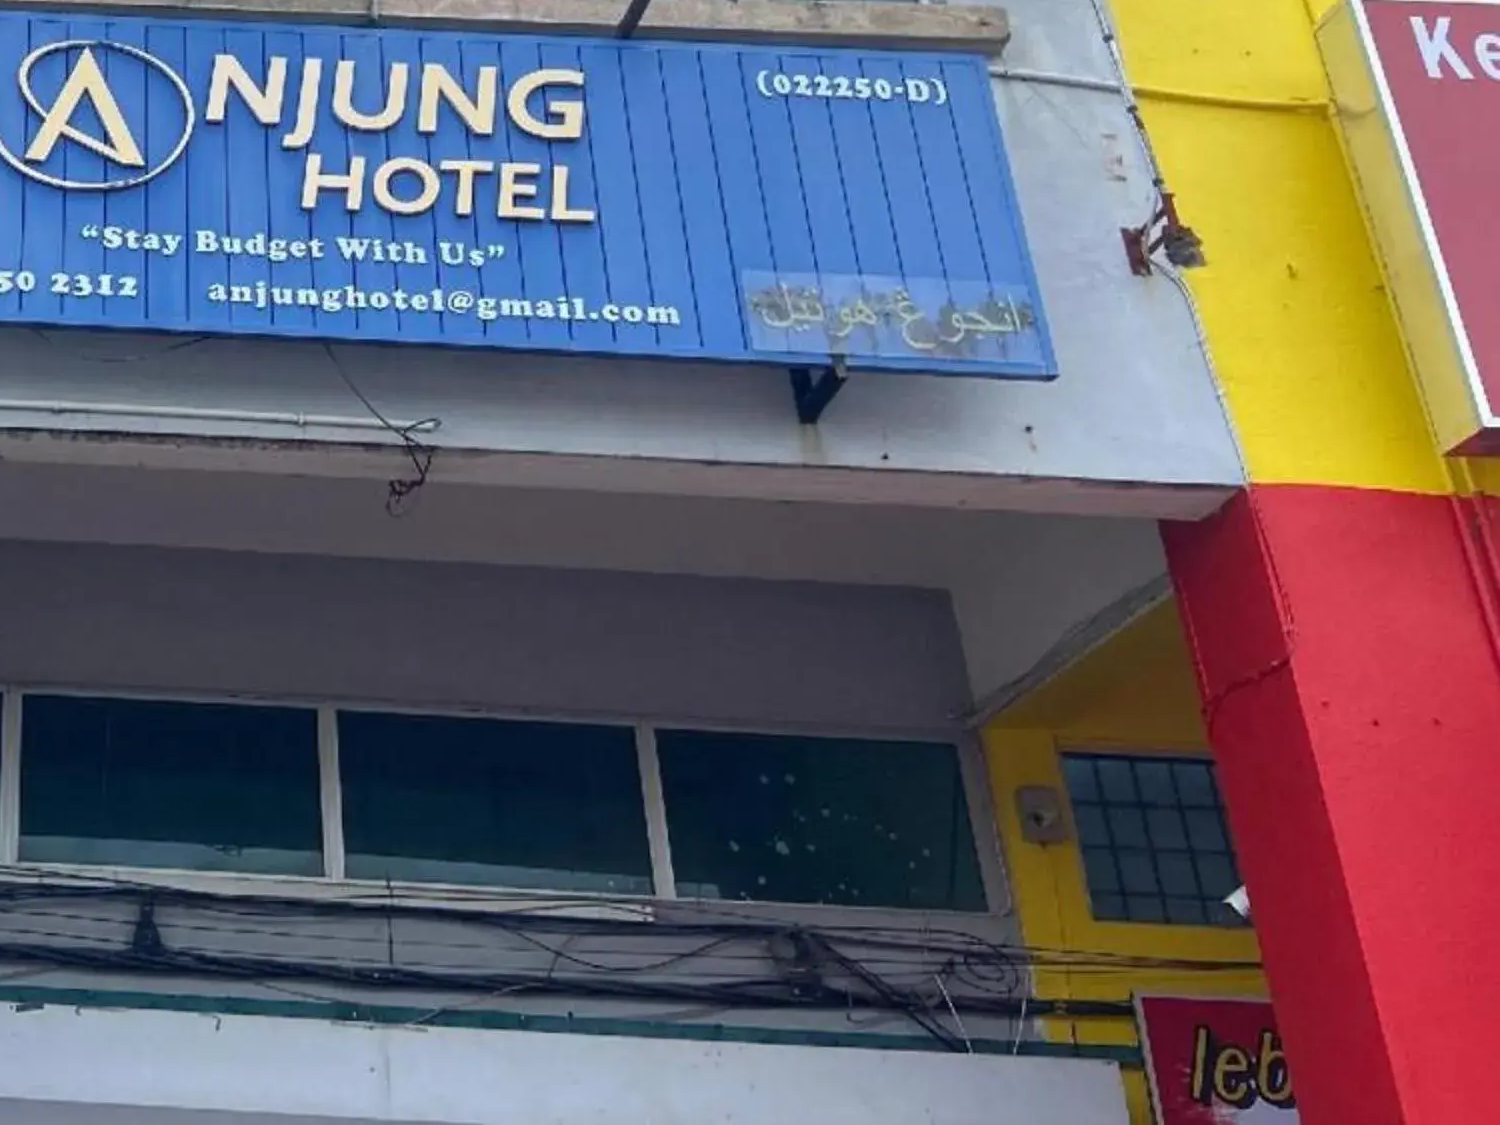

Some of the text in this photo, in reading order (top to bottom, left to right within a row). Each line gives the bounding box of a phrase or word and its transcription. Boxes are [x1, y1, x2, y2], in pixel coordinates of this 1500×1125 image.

[757, 70, 947, 104] (022250-D)
[301, 154, 595, 222] HOTEL
[195, 230, 324, 262] Budget
[337, 237, 427, 264] With
[50, 272, 138, 297] 2312
[208, 280, 681, 325] anjunghotel@gmail.com
